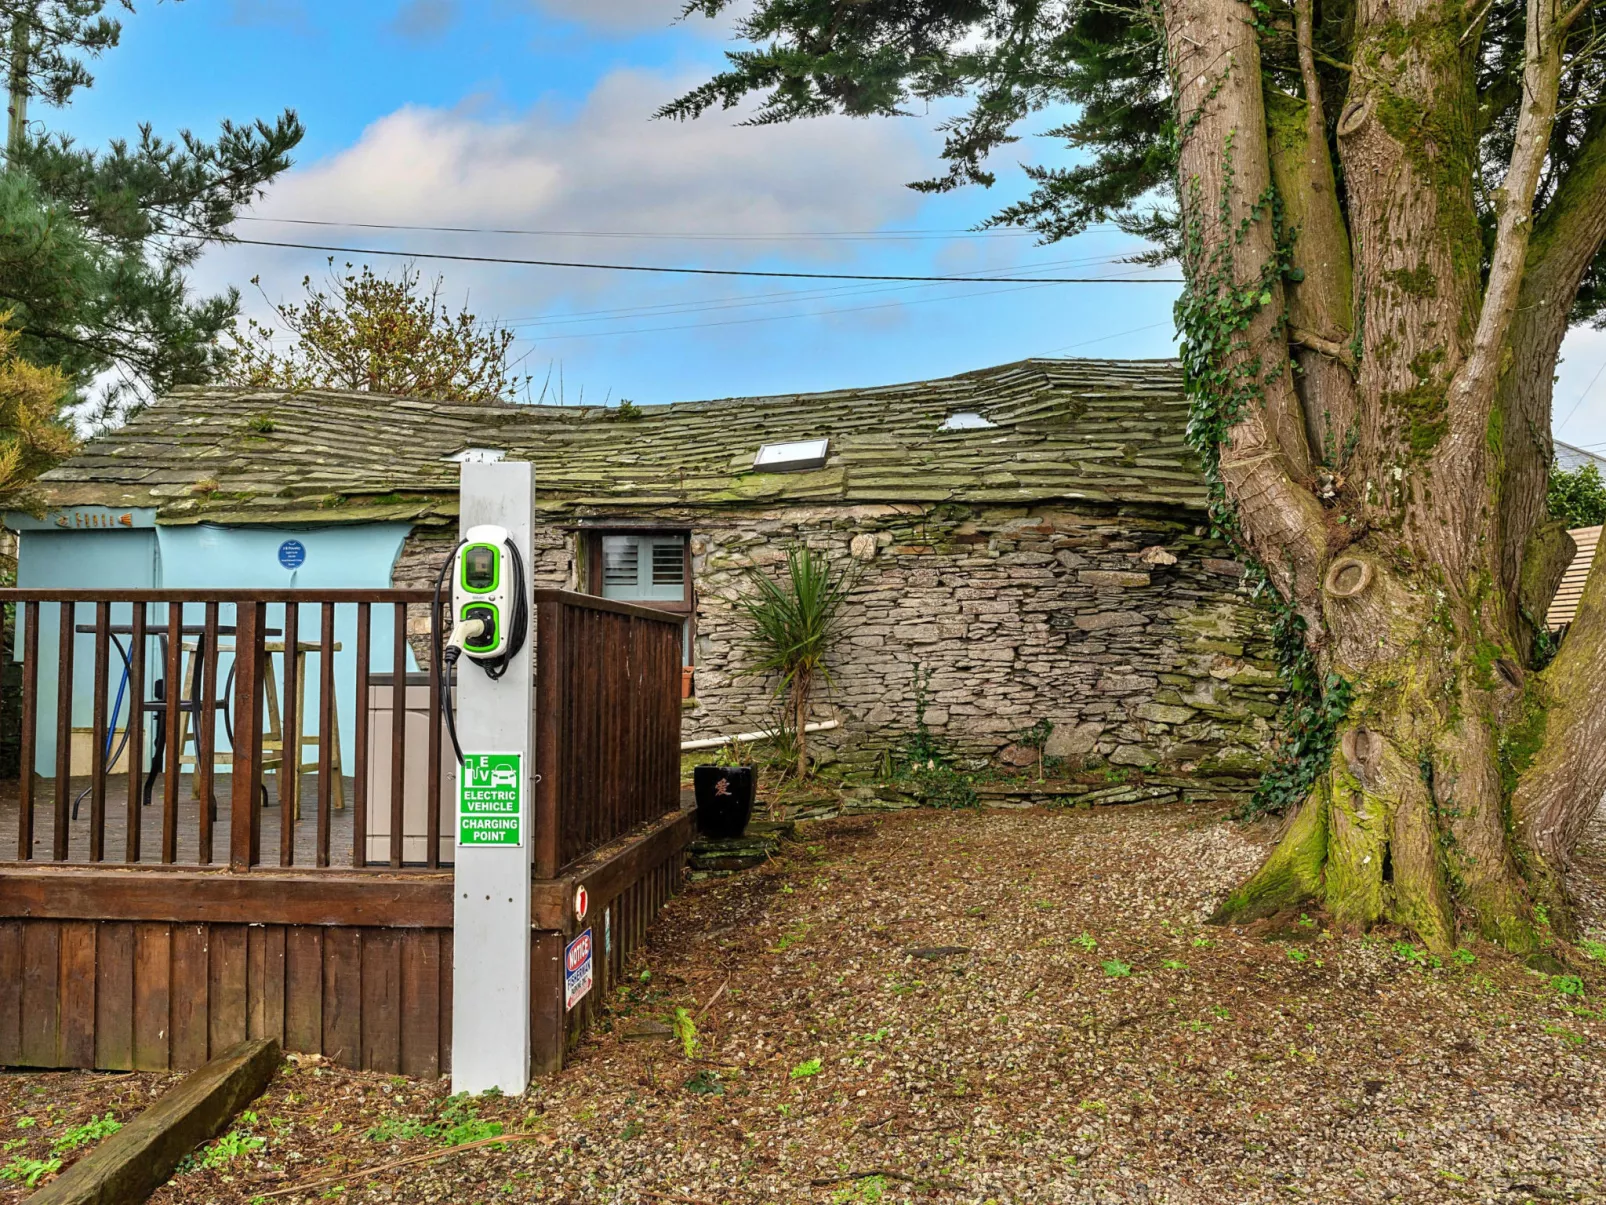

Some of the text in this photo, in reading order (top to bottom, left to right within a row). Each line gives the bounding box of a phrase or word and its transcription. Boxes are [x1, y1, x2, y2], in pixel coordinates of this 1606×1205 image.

[464, 791, 516, 800] ELECTRIC
[467, 802, 513, 811] VEHICLE
[462, 819, 518, 829] CHARGING
[473, 831, 506, 841] POINT
[569, 937, 589, 967] NOTICE
[567, 960, 591, 991] FISHERMAN
